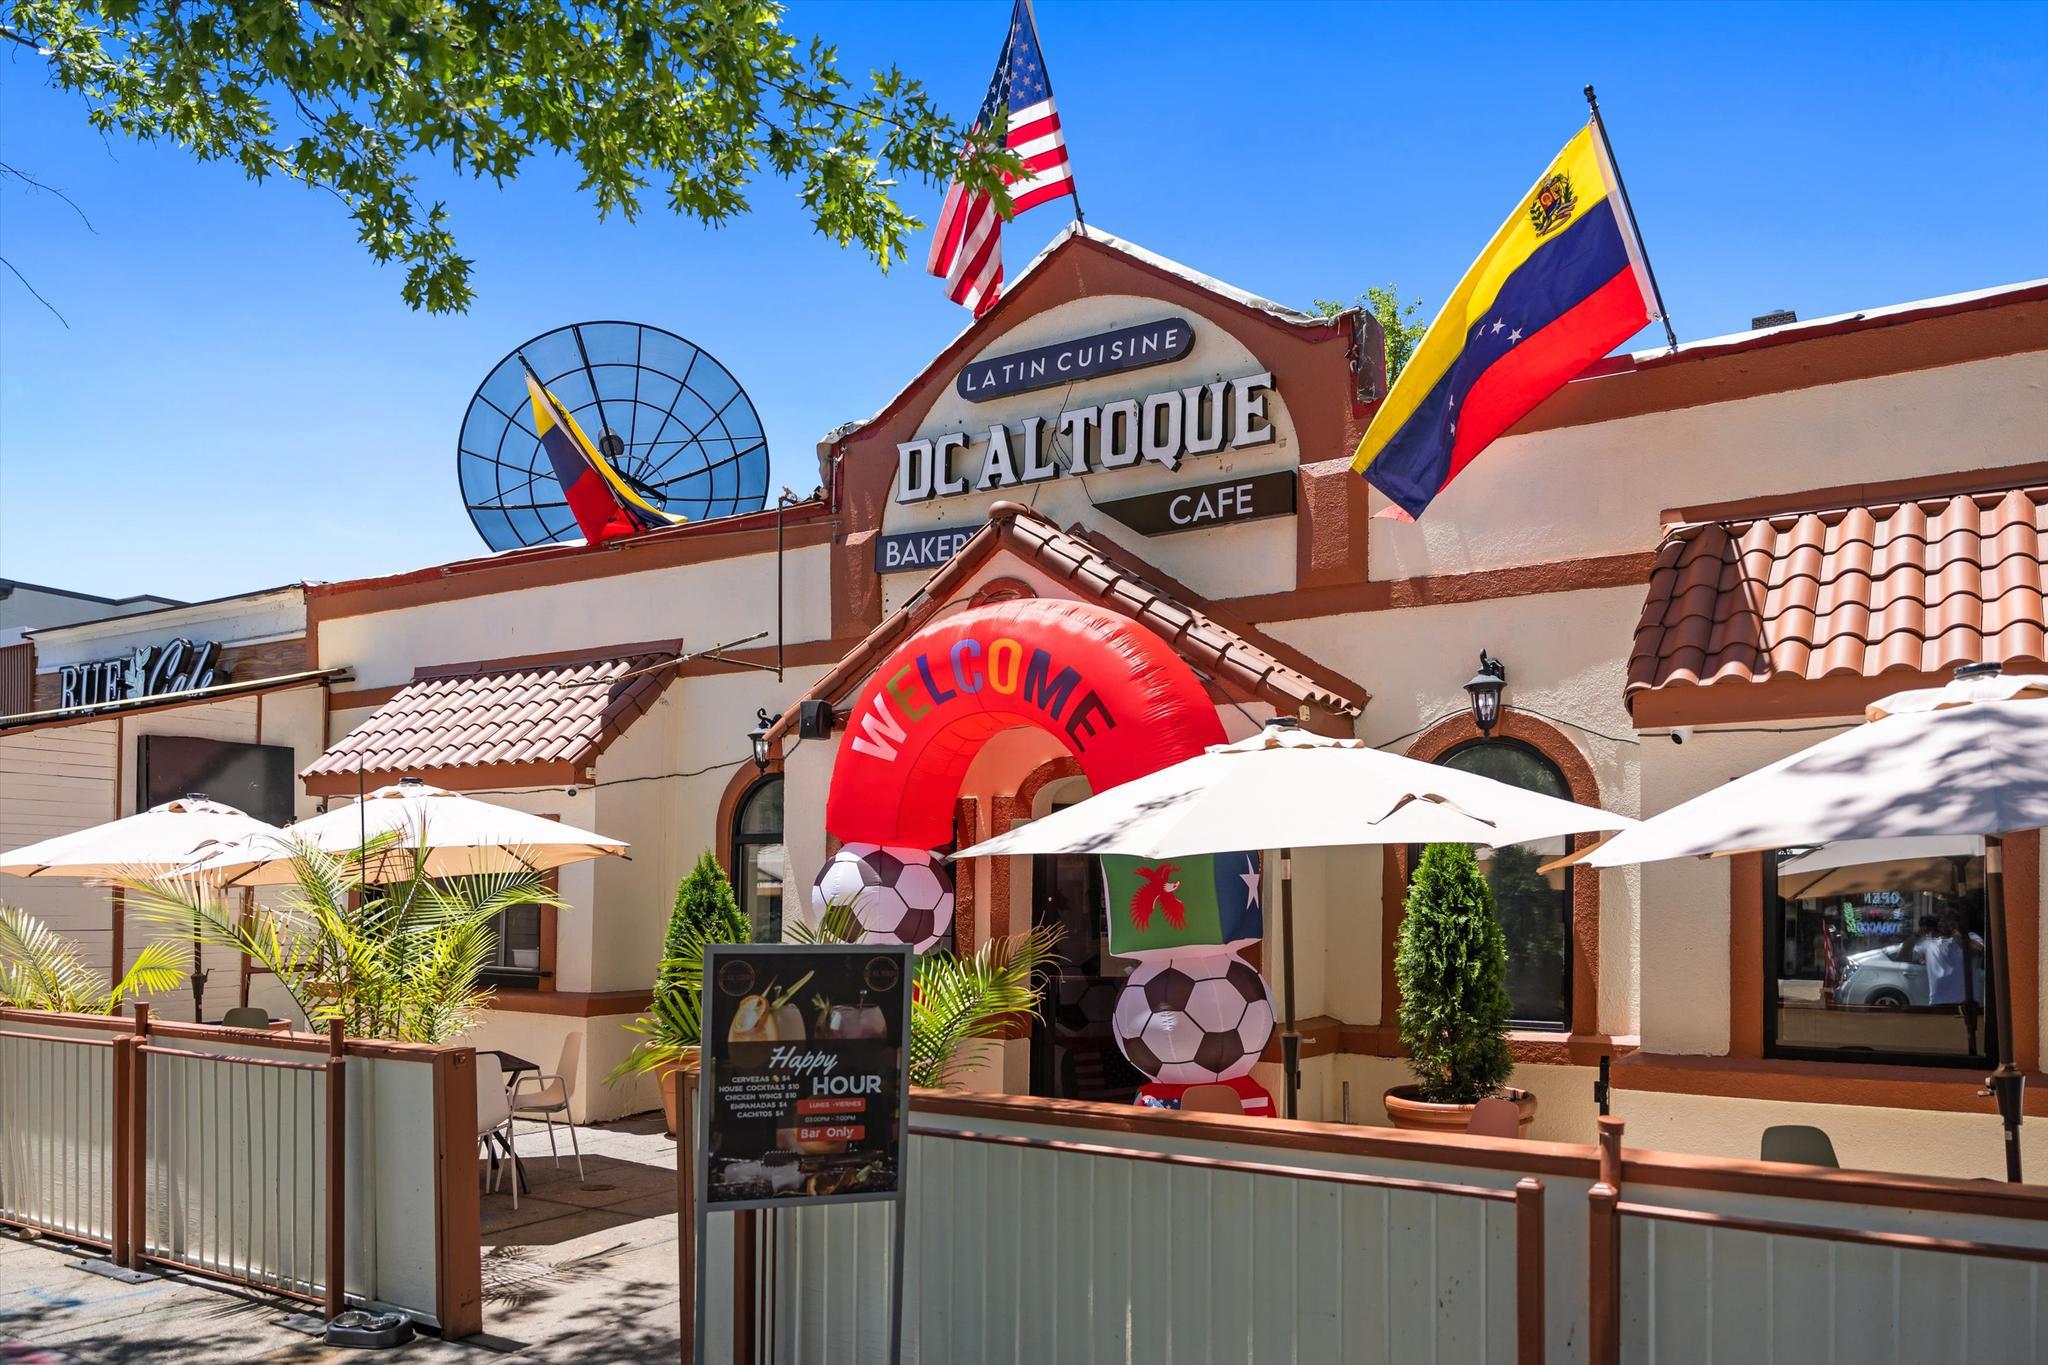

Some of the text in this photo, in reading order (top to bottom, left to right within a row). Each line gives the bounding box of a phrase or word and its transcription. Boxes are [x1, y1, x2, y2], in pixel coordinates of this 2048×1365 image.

[966, 328, 1178, 392] LATIN CUISINE
[896, 432, 970, 504] DC
[1169, 483, 1254, 525] CAFE
[885, 531, 973, 567] BAKER
[59, 660, 122, 717] RUE
[851, 638, 1117, 762] WELCOME
[769, 1045, 838, 1076] Happy
[718, 1085, 744, 1093] HOUSE
[813, 1075, 881, 1095] HOUR
[800, 1126, 855, 1139] Bar Only
